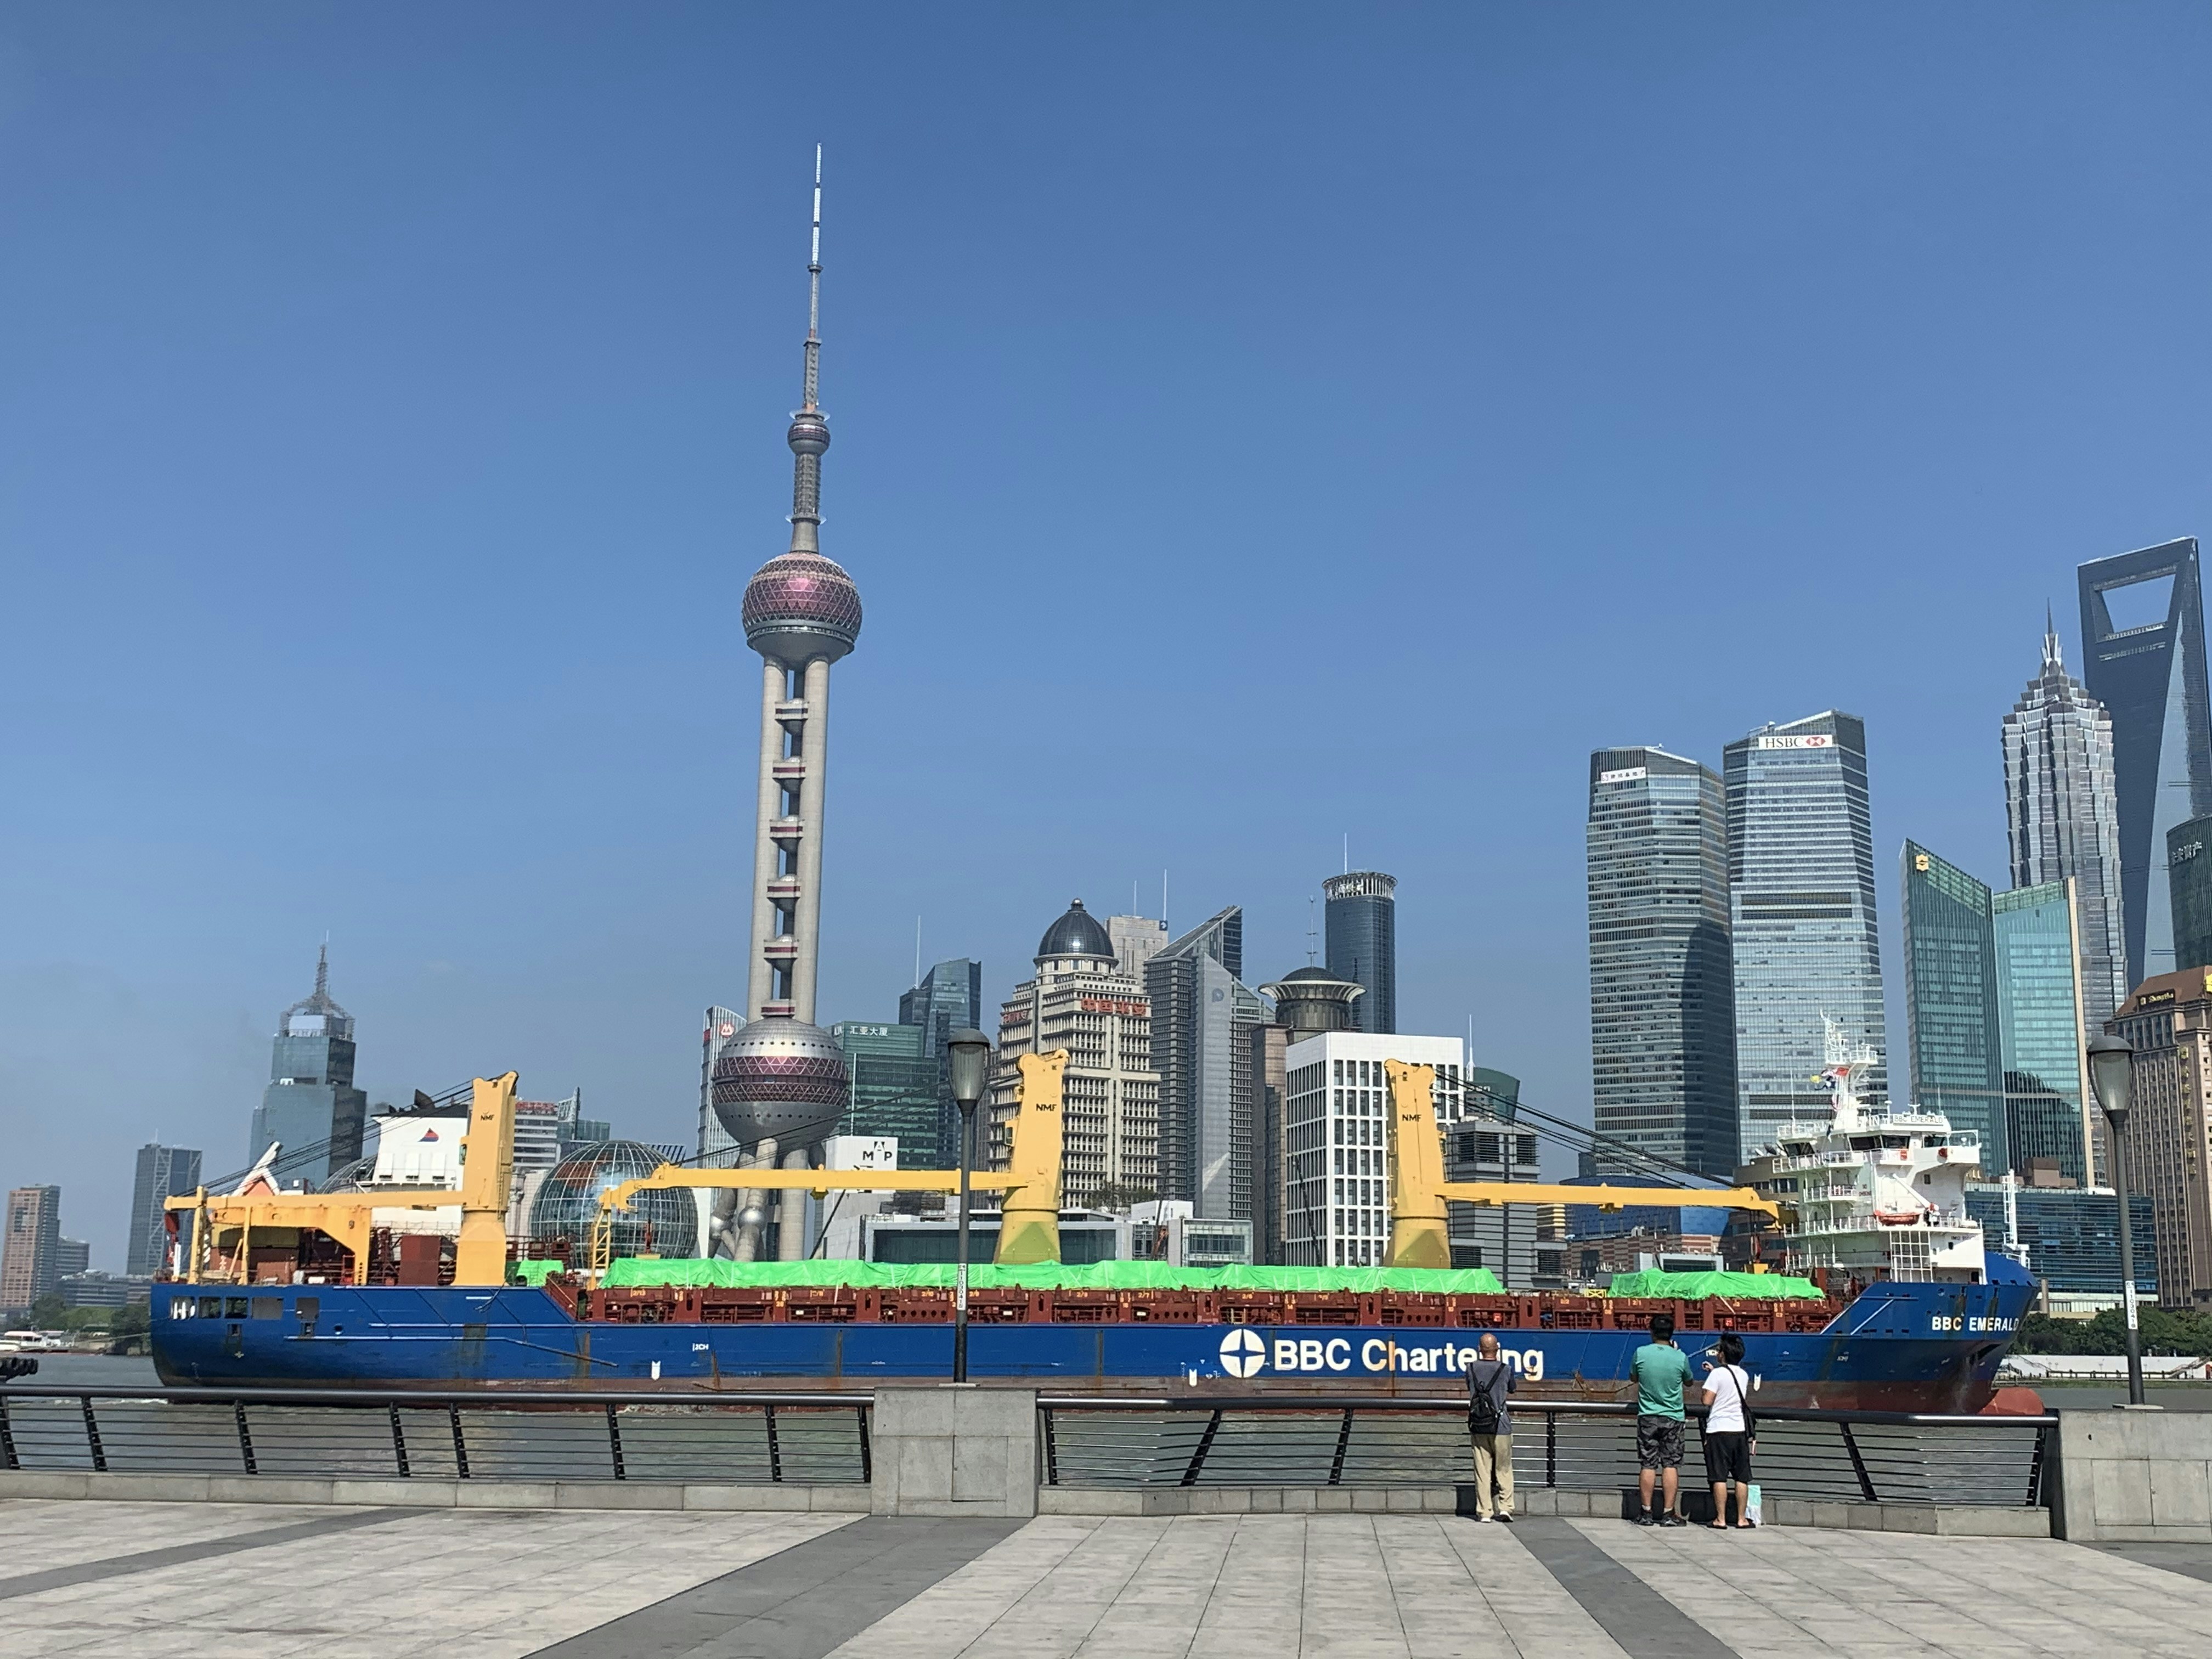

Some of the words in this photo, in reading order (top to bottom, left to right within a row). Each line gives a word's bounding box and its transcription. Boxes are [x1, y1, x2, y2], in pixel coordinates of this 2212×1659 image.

[1765, 737, 1804, 748] HSBC
[1081, 998, 1147, 1015] 中国平安
[850, 1025, 888, 1036] 汇亚大厦
[1036, 1103, 1057, 1111] NMF
[1402, 1114, 1422, 1122] NMF
[1911, 1115, 1943, 1124] EMERALD
[1932, 1316, 1962, 1330] BBC
[1969, 1317, 2020, 1331] EMERALD
[1274, 1338, 1352, 1372] BBC
[1362, 1338, 1544, 1381] Charteng
